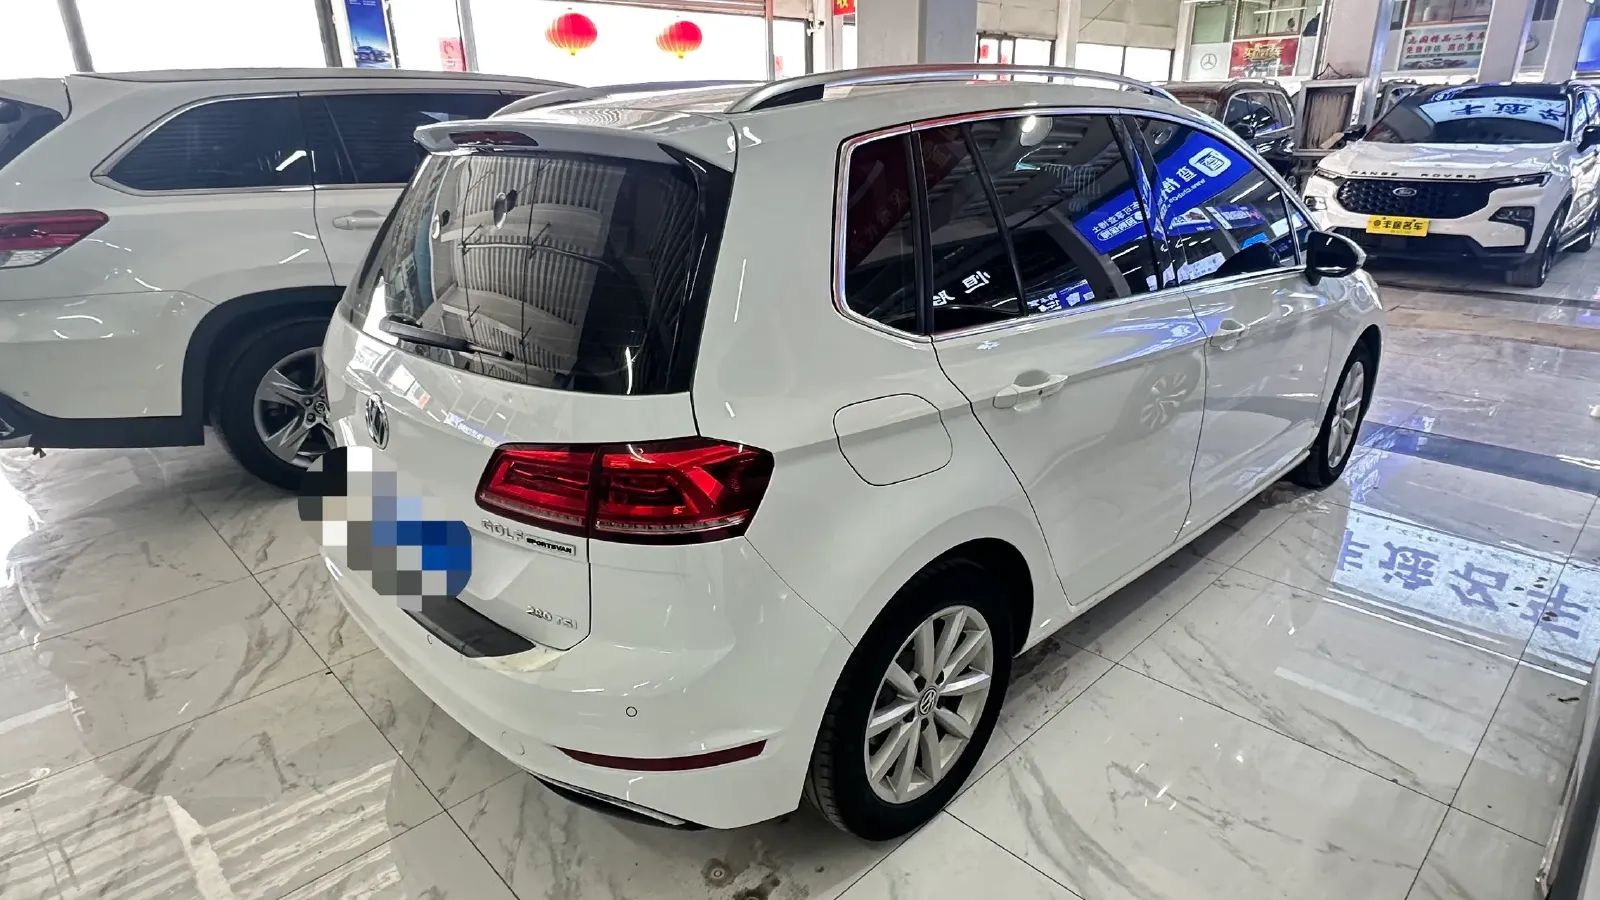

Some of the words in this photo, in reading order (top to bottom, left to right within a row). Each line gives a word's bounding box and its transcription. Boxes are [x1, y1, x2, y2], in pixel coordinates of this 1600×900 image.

[1350, 169, 1400, 177] RANGE
[482, 517, 524, 542] GOLF
[526, 537, 572, 554] SPORTSVAN
[526, 605, 553, 621] 280
[555, 614, 578, 630] TSI
